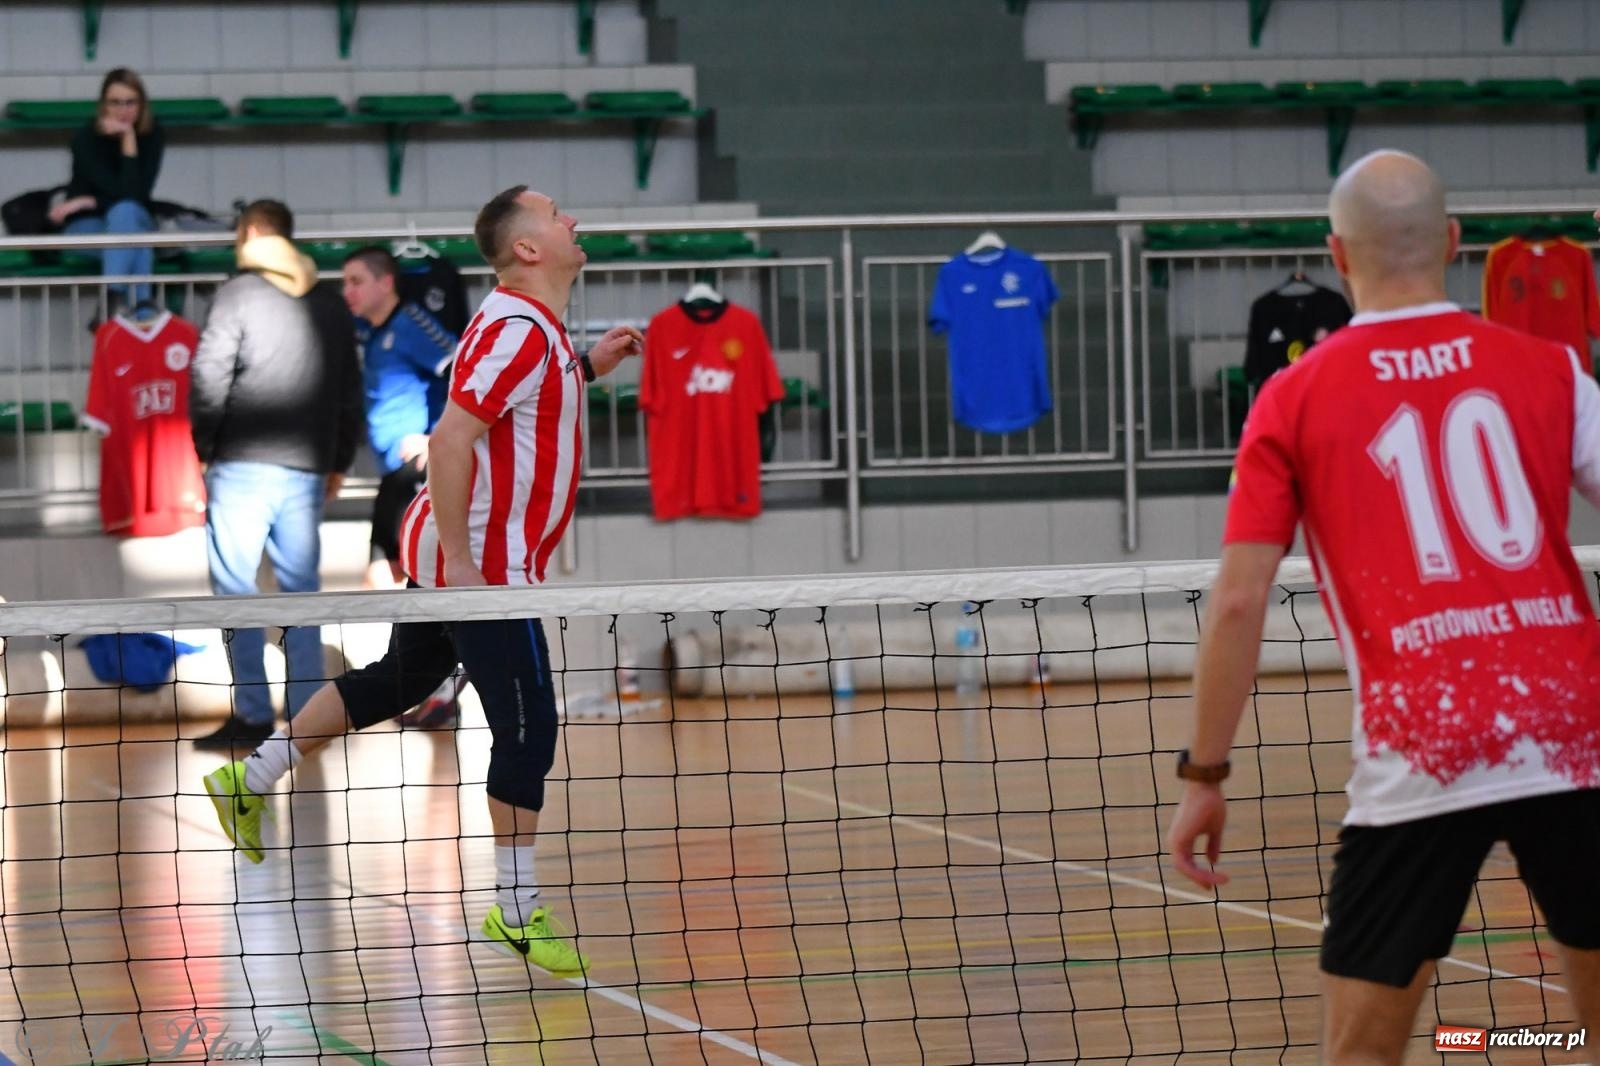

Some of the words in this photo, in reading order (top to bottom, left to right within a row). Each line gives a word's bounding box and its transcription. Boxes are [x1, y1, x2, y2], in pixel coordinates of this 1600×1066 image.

[1368, 336, 1474, 382] START
[1366, 388, 1544, 585] 10
[1391, 602, 1514, 654] PIETROWICE
